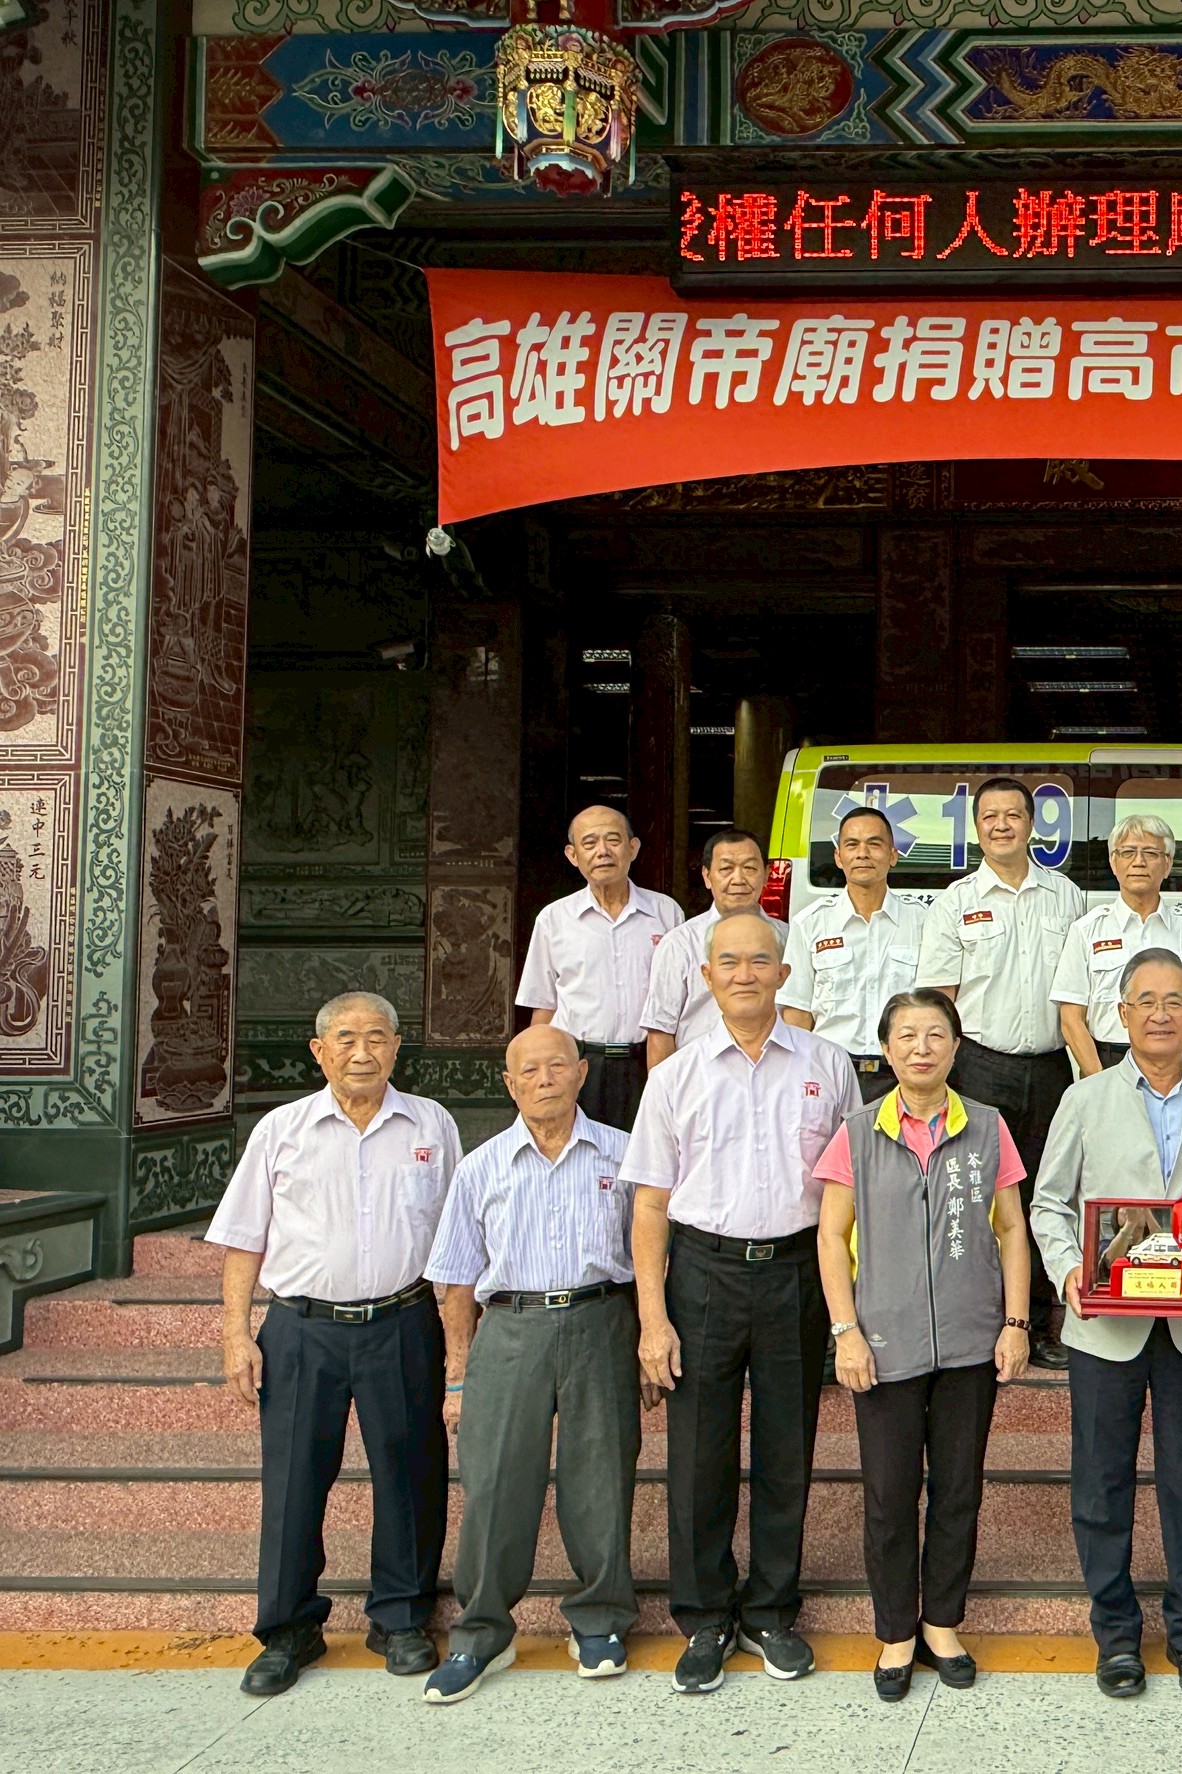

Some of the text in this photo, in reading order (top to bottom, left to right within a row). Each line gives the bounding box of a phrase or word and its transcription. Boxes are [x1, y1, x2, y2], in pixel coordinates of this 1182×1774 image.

[28, 795, 48, 880] 連中三元
[942, 782, 1073, 869] 19
[966, 1151, 984, 1203] 苓雅區
